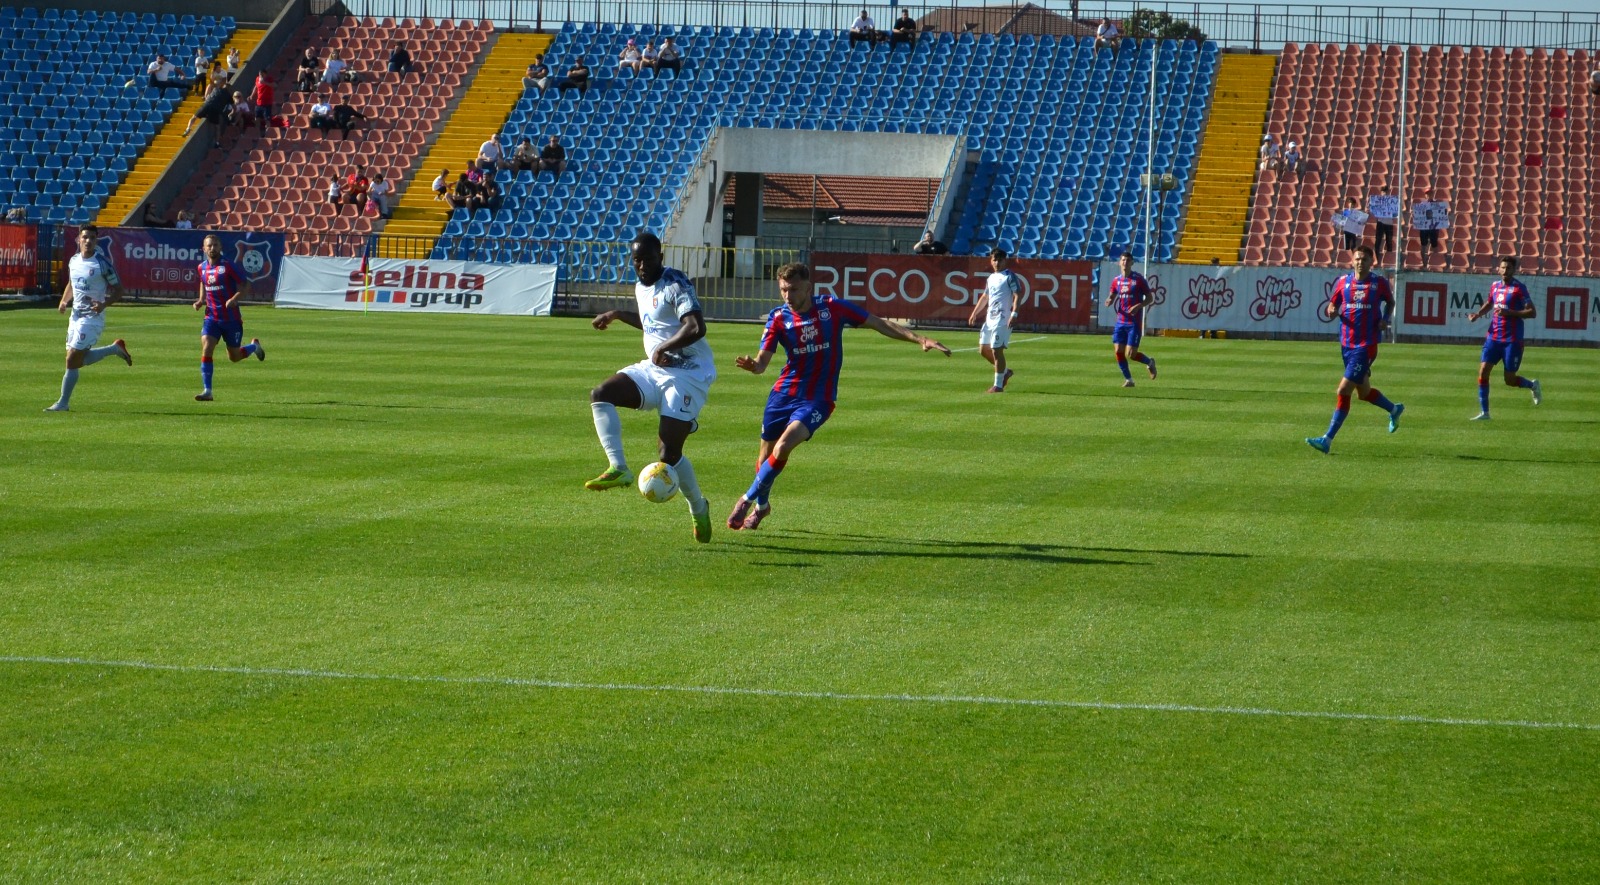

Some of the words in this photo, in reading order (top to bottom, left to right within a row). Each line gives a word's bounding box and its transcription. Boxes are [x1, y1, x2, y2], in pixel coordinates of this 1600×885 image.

[124, 243, 223, 261] fcbihor.
[348, 265, 485, 290] selina
[813, 265, 931, 303] RECO
[1189, 274, 1226, 297] Viva
[1256, 275, 1294, 298] Viva
[410, 291, 482, 309] grup
[1181, 289, 1234, 319] Chips
[1249, 290, 1302, 321] Chips
[792, 342, 830, 354] selina
[811, 410, 822, 423] 28
